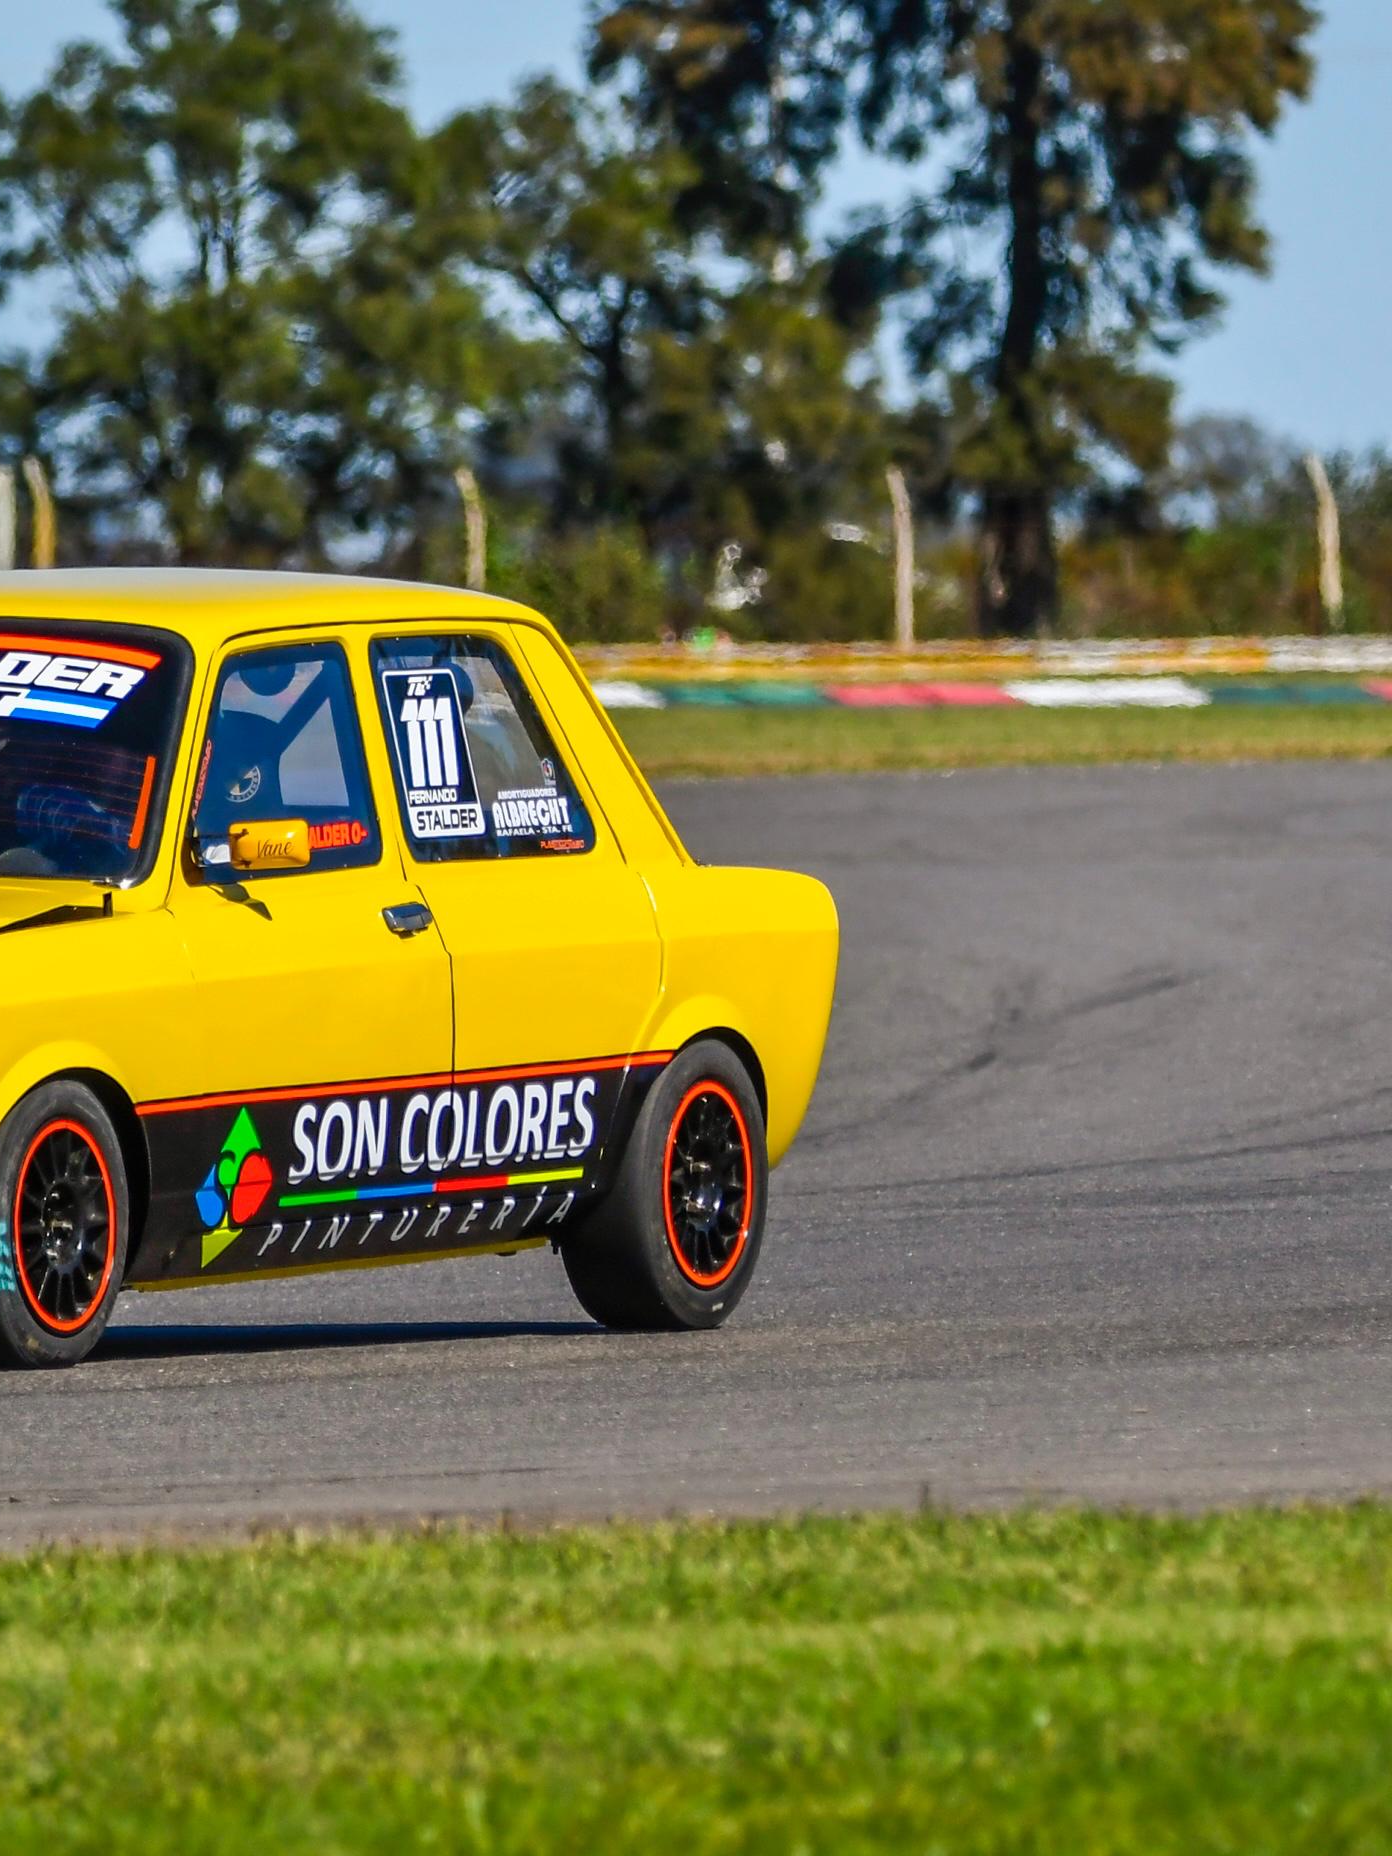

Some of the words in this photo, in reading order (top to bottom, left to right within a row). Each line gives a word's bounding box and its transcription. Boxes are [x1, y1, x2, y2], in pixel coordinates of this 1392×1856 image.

[400, 697, 459, 788] 111
[408, 789, 457, 805] FERNANDO
[497, 787, 557, 800] AMORTIGUADORES
[416, 808, 478, 832] STALDER
[492, 797, 570, 829] ALBRECHT
[496, 826, 535, 837] RAFAELA
[562, 824, 574, 833] FE
[257, 840, 294, 857] Vane
[287, 1093, 388, 1185] SON
[398, 1077, 598, 1174] COLORES
[256, 1186, 578, 1257] PINTURERÍA
